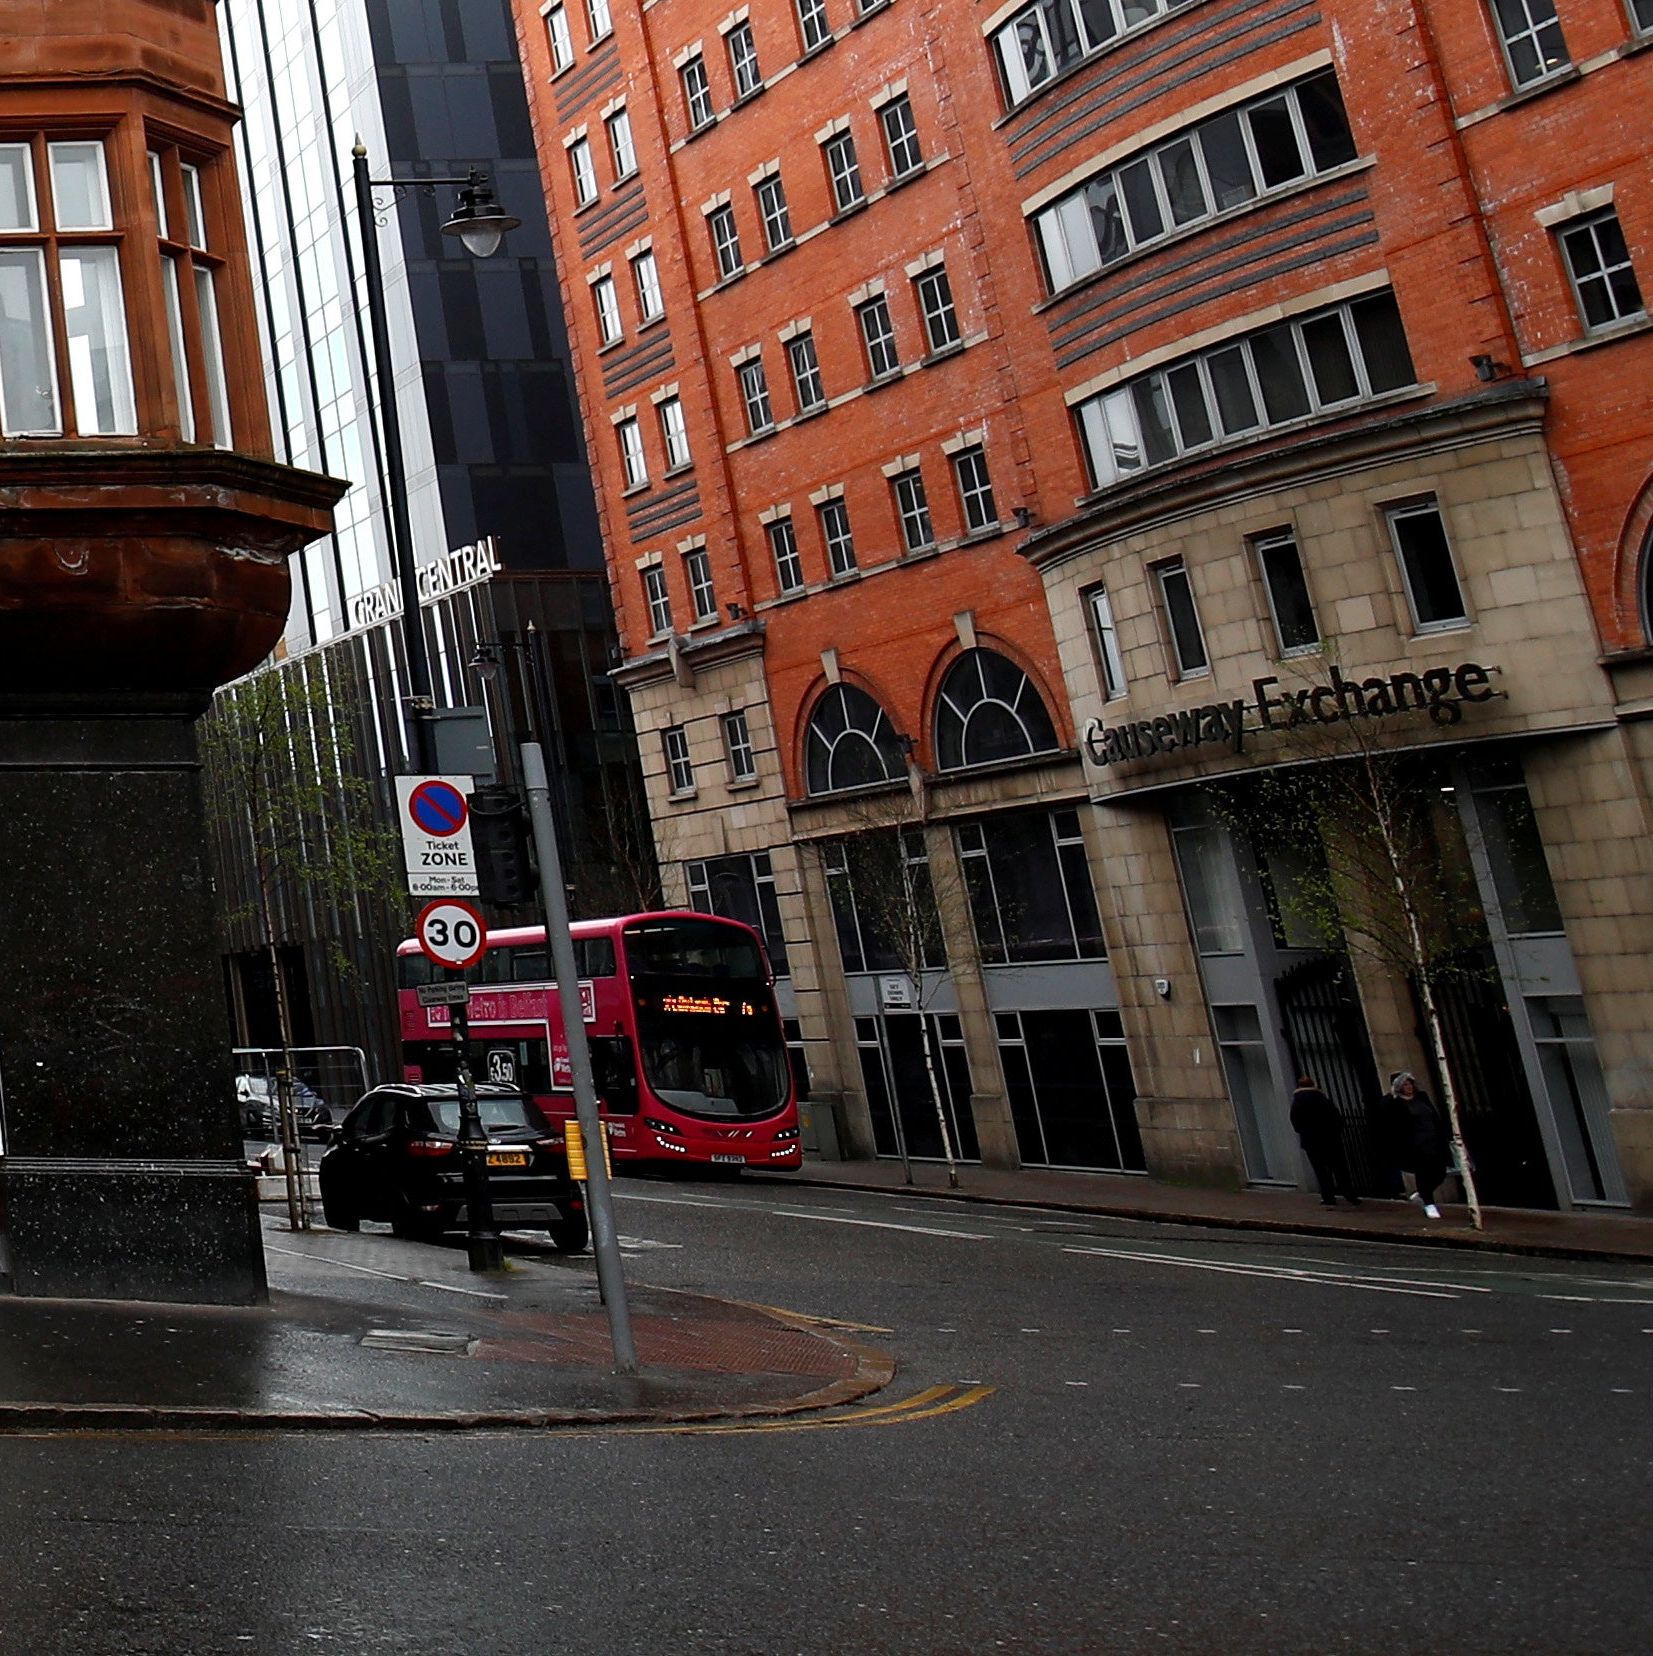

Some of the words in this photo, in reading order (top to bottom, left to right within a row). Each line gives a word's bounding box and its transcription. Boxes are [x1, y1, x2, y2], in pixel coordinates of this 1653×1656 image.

[352, 576, 405, 627] GRAN
[415, 535, 502, 601] CENTRAL
[1084, 698, 1245, 767] Causeway
[1252, 662, 1494, 726] Exchange
[421, 852, 468, 866] ZONE
[426, 841, 460, 851] Ticket
[427, 919, 477, 948] 30
